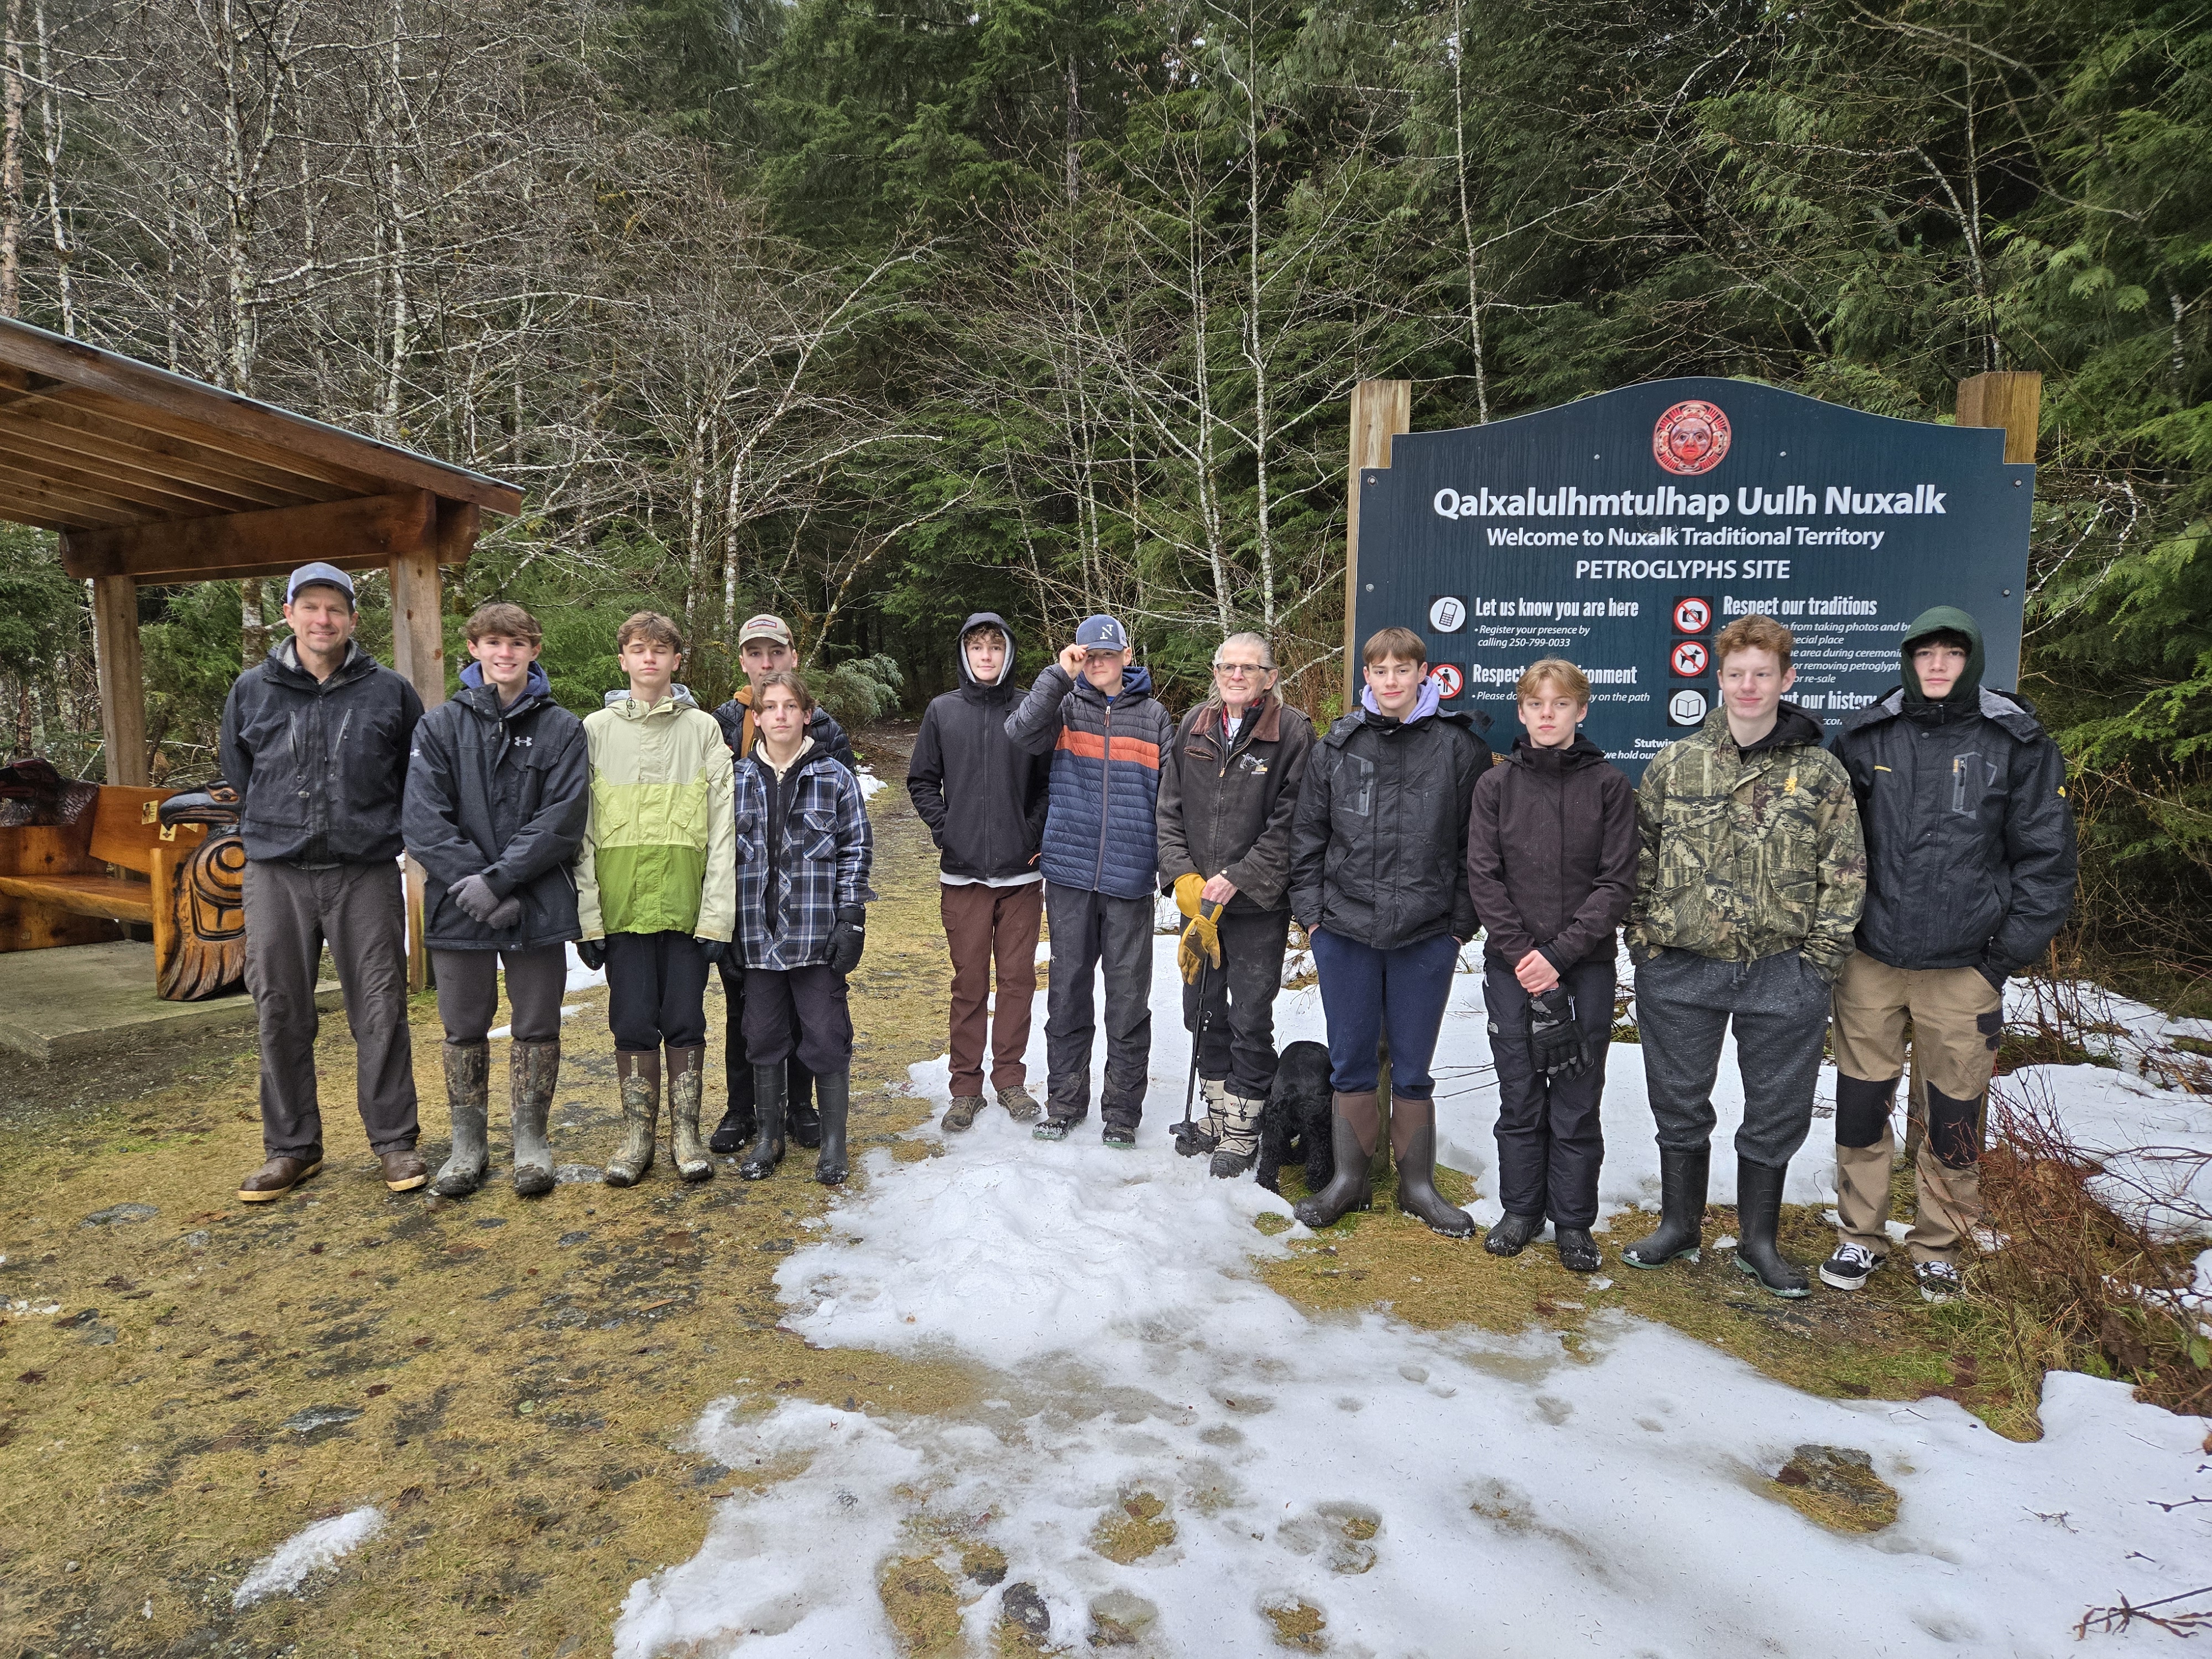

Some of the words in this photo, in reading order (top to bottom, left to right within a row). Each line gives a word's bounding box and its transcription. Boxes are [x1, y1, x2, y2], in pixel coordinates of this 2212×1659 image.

[1433, 486, 1730, 523] Qalxalulhmtulhap
[1738, 485, 1817, 515] Uulh
[1824, 484, 1947, 514] Nuxalk
[1486, 527, 1579, 546] Welcome
[1582, 529, 1604, 546] to
[1608, 526, 1679, 546] Nuxalk
[1681, 526, 1792, 545] Traditional
[1794, 526, 1885, 550] Territory
[1575, 560, 1737, 579] PETROGLYPHS
[1741, 560, 1791, 579] SITE
[1475, 597, 1497, 617] Let
[1500, 601, 1516, 617] us
[1519, 597, 1553, 617] know
[1555, 602, 1580, 621] you
[1583, 602, 1605, 617] are
[1608, 597, 1639, 617] here
[1723, 596, 1780, 616] Respect
[1781, 600, 1806, 615] our
[1808, 596, 1877, 615] traditions
[1479, 625, 1516, 636] Register
[1515, 627, 1538, 637] your
[1537, 627, 1578, 637] presence
[1578, 625, 1591, 637] by
[1790, 622, 1813, 631] from
[1814, 622, 1845, 633] taking
[1845, 622, 1880, 633] photos
[1880, 622, 1901, 632] and
[1478, 637, 1508, 649] calling
[1509, 638, 1571, 647] 250-799-0033
[1792, 635, 1817, 644] ecial
[1816, 634, 1844, 646] place
[1822, 648, 1855, 659] during
[1803, 661, 1849, 672] removing
[1473, 664, 1526, 687] Respect
[1578, 664, 1638, 685] ronment
[1804, 674, 1837, 683] re-sale
[1477, 691, 1505, 700] Please
[1612, 692, 1627, 701] the
[1627, 692, 1650, 703] path
[1801, 695, 1825, 709] our
[1617, 750, 1640, 759] hold
